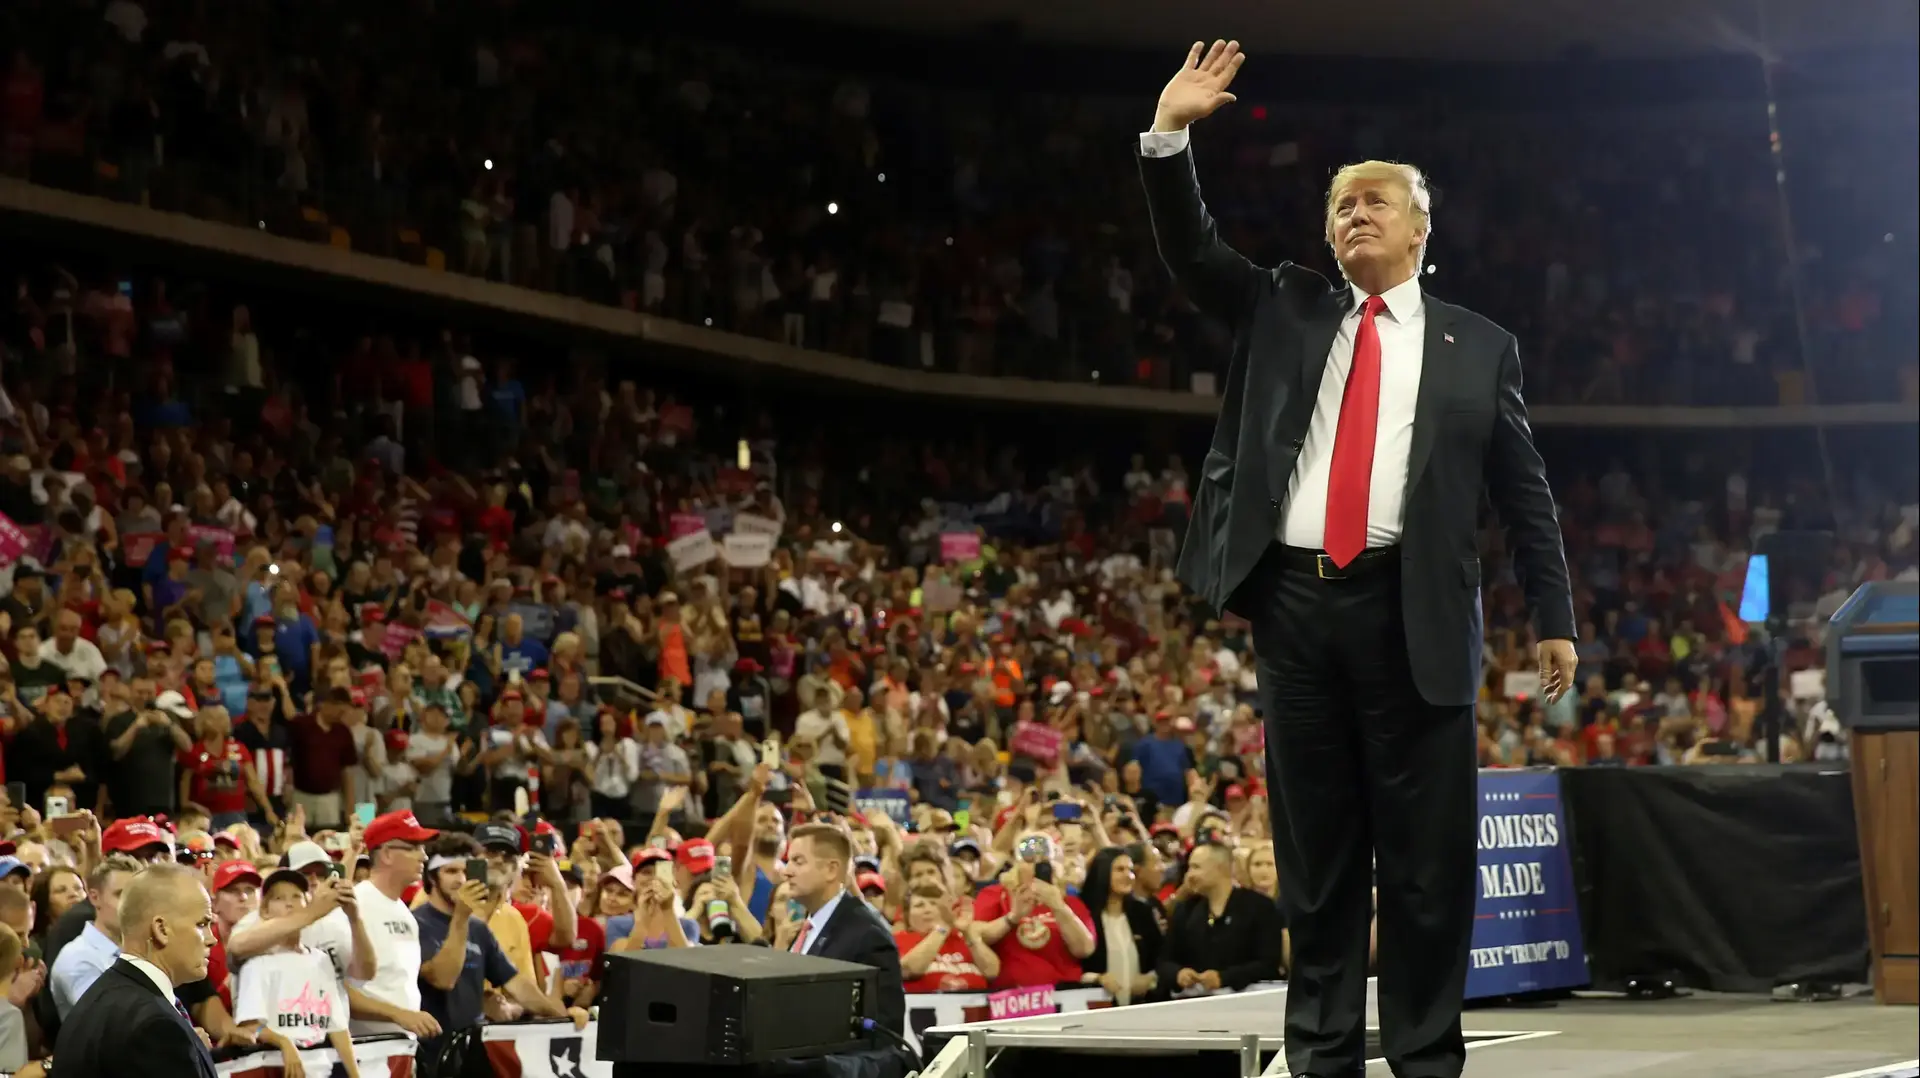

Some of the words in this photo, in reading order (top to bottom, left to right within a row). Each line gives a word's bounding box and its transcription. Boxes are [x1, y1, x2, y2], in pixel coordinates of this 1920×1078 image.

[1477, 813, 1559, 849] OMISES
[1479, 862, 1546, 898] MADE
[1470, 946, 1504, 969] TEXT
[1553, 940, 1570, 960] TO
[989, 990, 1055, 1018] WOMEN
